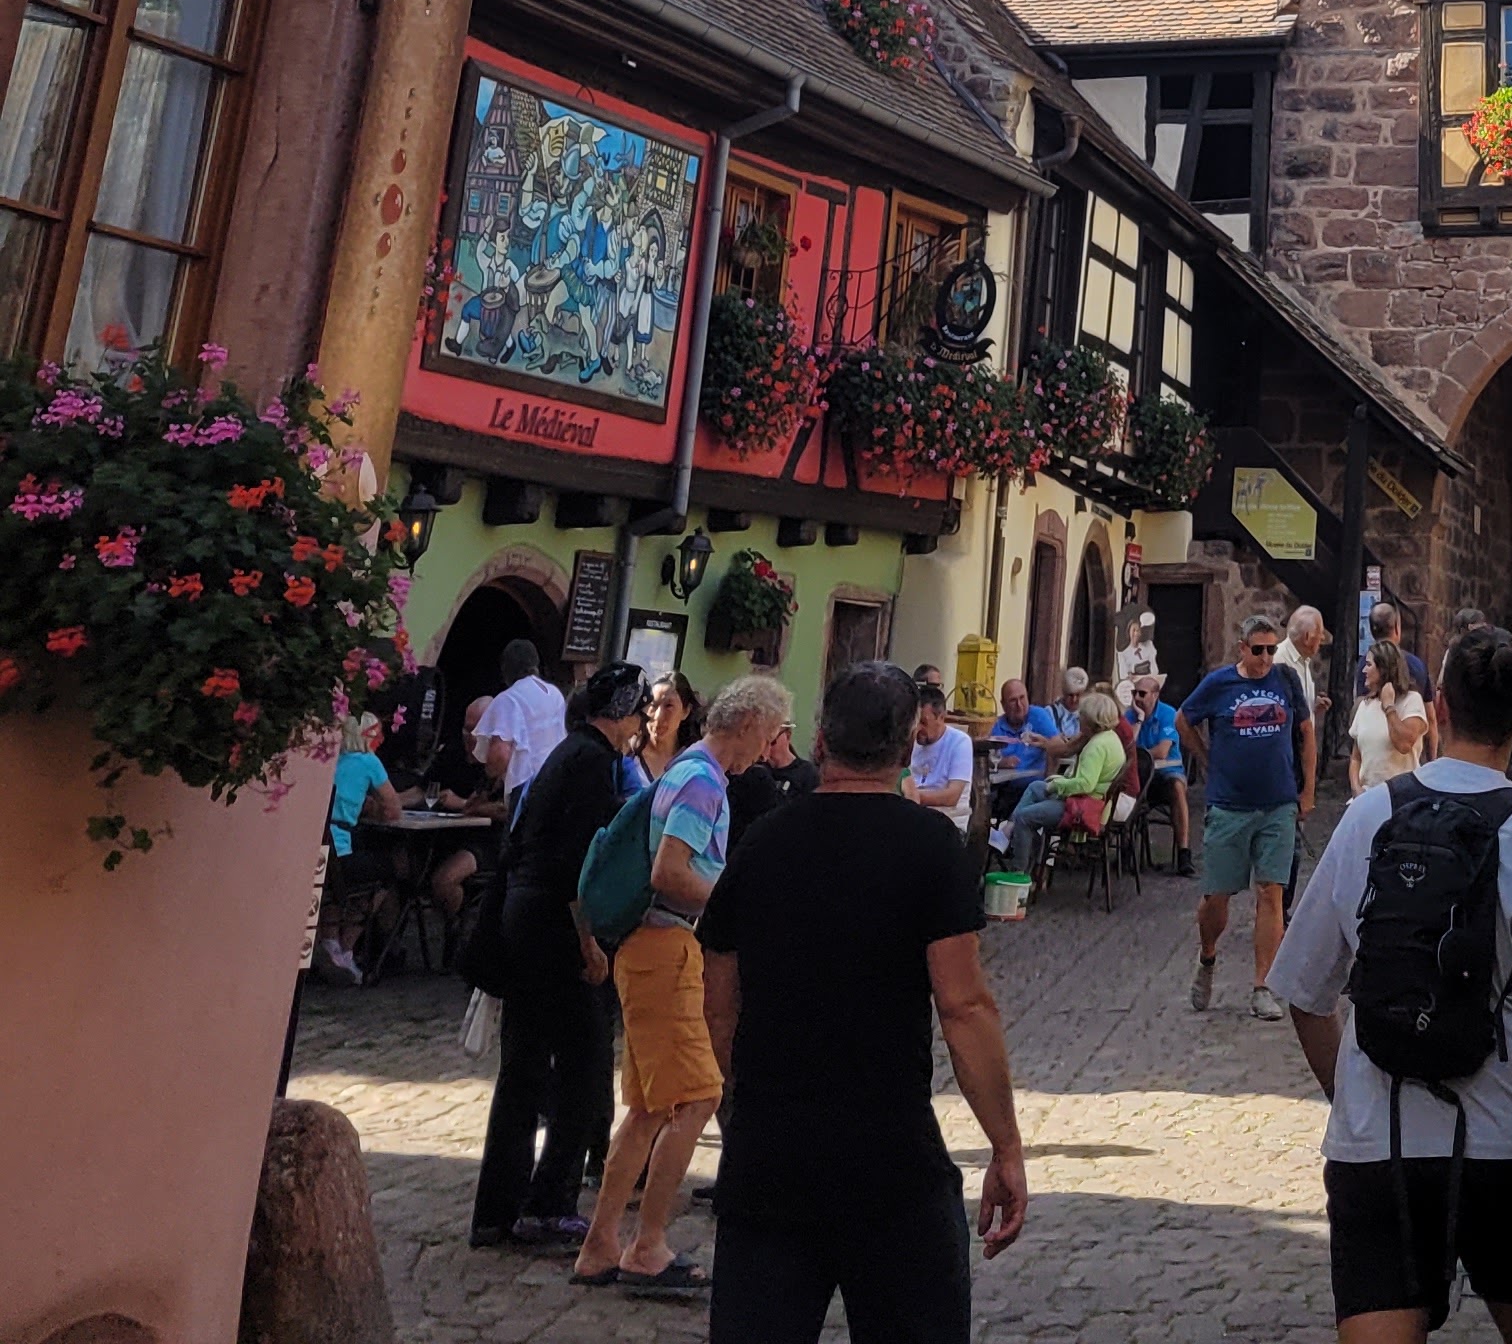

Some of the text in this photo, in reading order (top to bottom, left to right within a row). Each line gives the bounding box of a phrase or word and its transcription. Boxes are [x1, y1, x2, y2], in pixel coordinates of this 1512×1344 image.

[488, 397, 600, 448] Le Médiéval
[1229, 689, 1285, 711] LAS VEGAS
[1239, 724, 1280, 736] NEVADA
